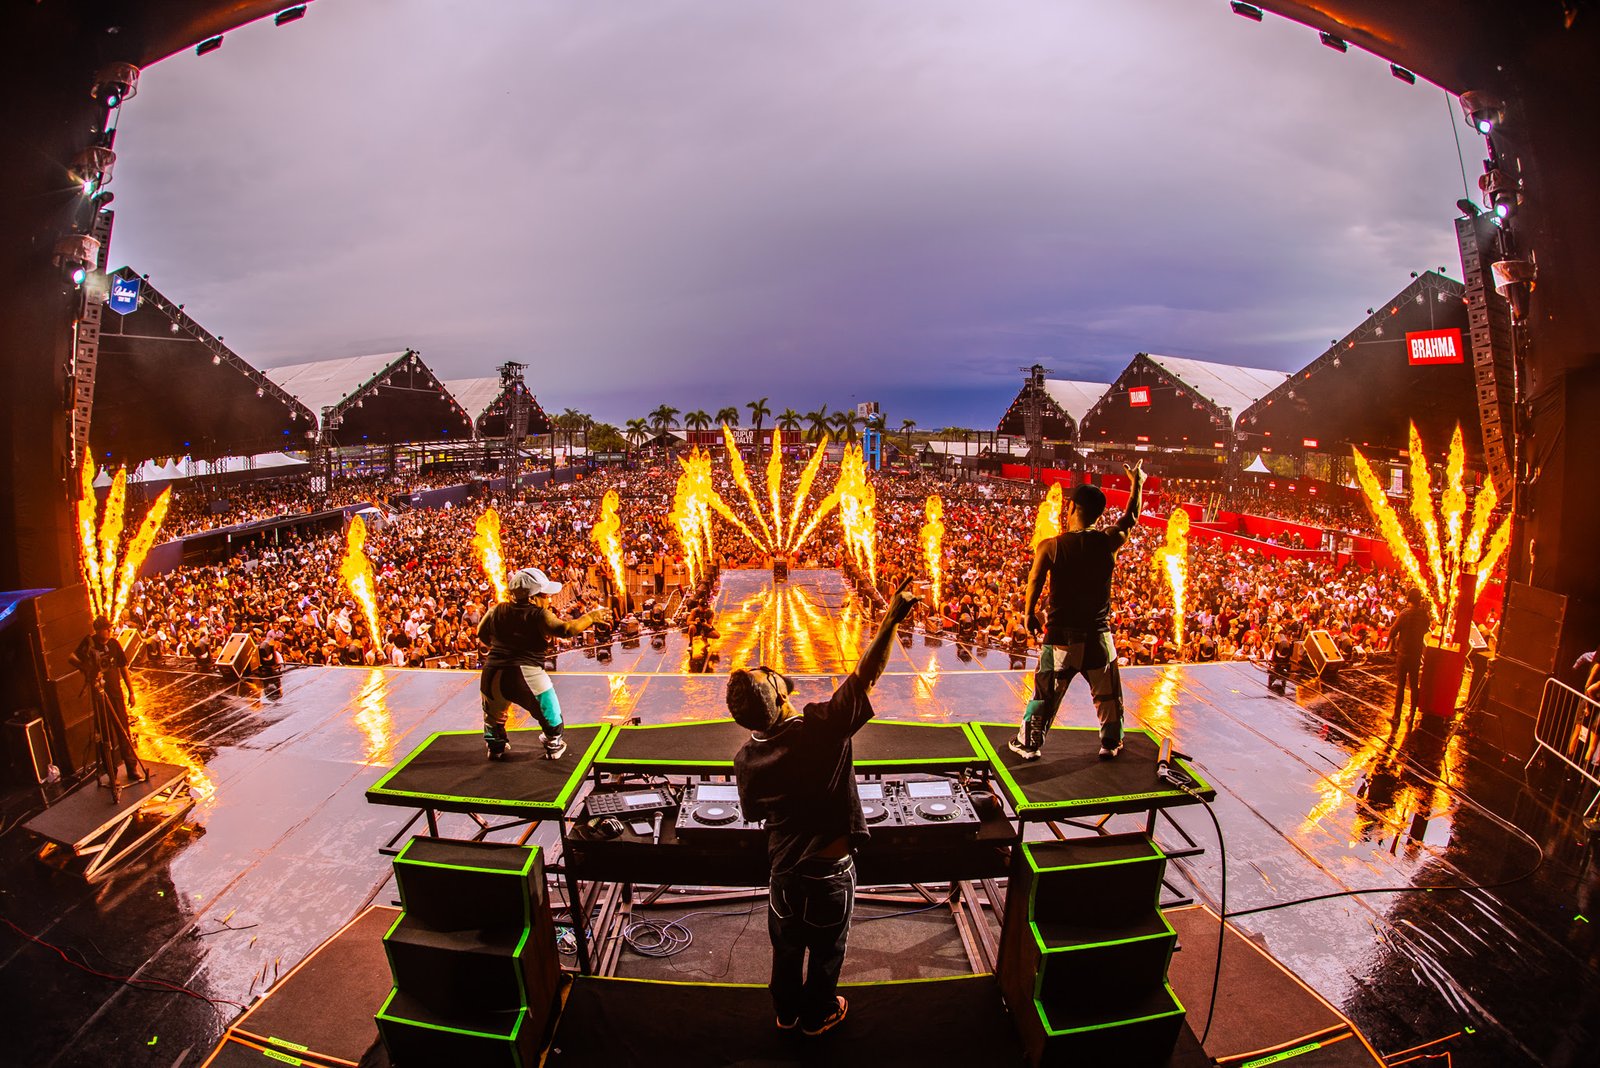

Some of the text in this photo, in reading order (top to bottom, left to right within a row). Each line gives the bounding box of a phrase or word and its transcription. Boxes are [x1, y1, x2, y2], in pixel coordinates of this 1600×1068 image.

[1411, 336, 1456, 359] BRAHMA
[733, 430, 754, 438] DUPLO
[1018, 802, 1058, 810] CUIDADO
[1122, 792, 1159, 800] CUIDADO
[267, 1050, 297, 1064] CUIDADO
[1247, 1044, 1315, 1068] CUIDADO CUIDADO
